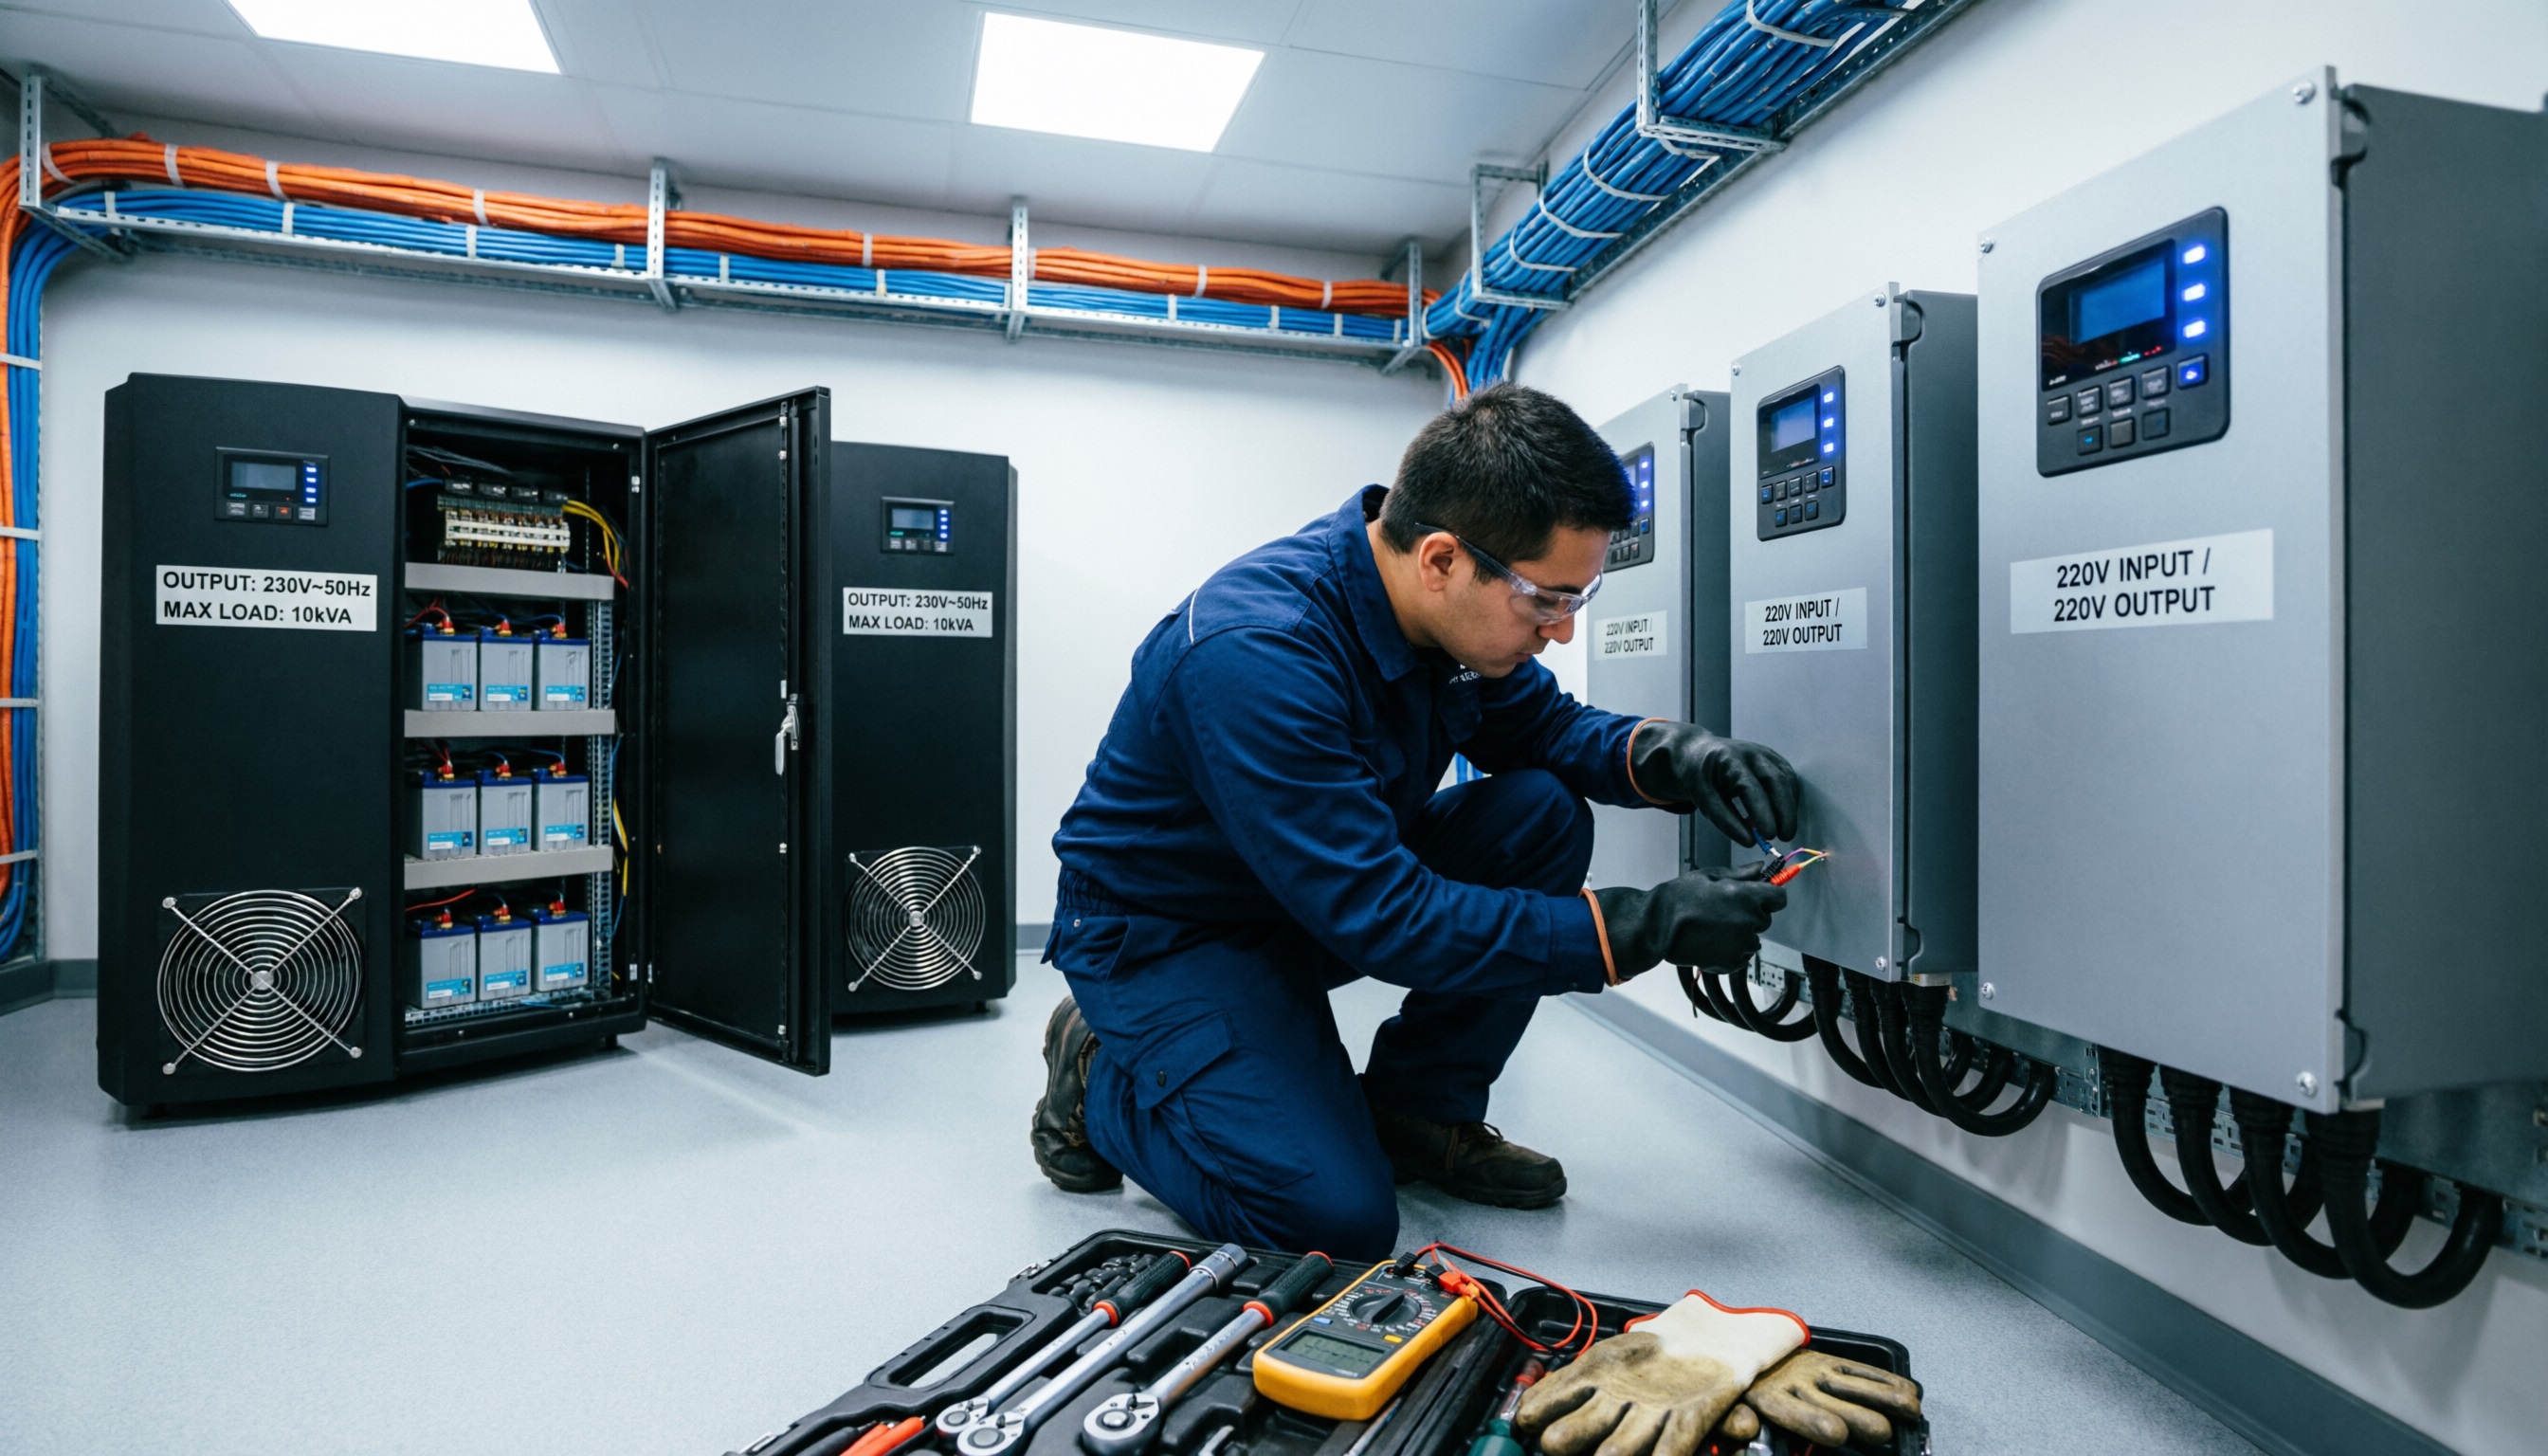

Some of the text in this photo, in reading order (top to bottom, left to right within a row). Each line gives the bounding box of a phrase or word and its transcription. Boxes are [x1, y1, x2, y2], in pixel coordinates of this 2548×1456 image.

[2057, 547, 2211, 589] 220V INPUT /
[163, 571, 371, 596] OUTPUT: 230V~50Hz
[848, 592, 988, 610] OUTPUT: 230V~50Hz
[1765, 597, 1840, 622] 220V INPUT /
[2053, 586, 2215, 623] 220V OUTPUT
[163, 601, 352, 624] MAX LOAD: 10kVA
[848, 614, 974, 631] MAX LOAD: 10kVA
[1606, 622, 1624, 636] 220V
[1625, 619, 1647, 634] INPUT
[1763, 624, 1843, 646] 220V OUTPUT
[1623, 637, 1653, 652] OUTPUT
